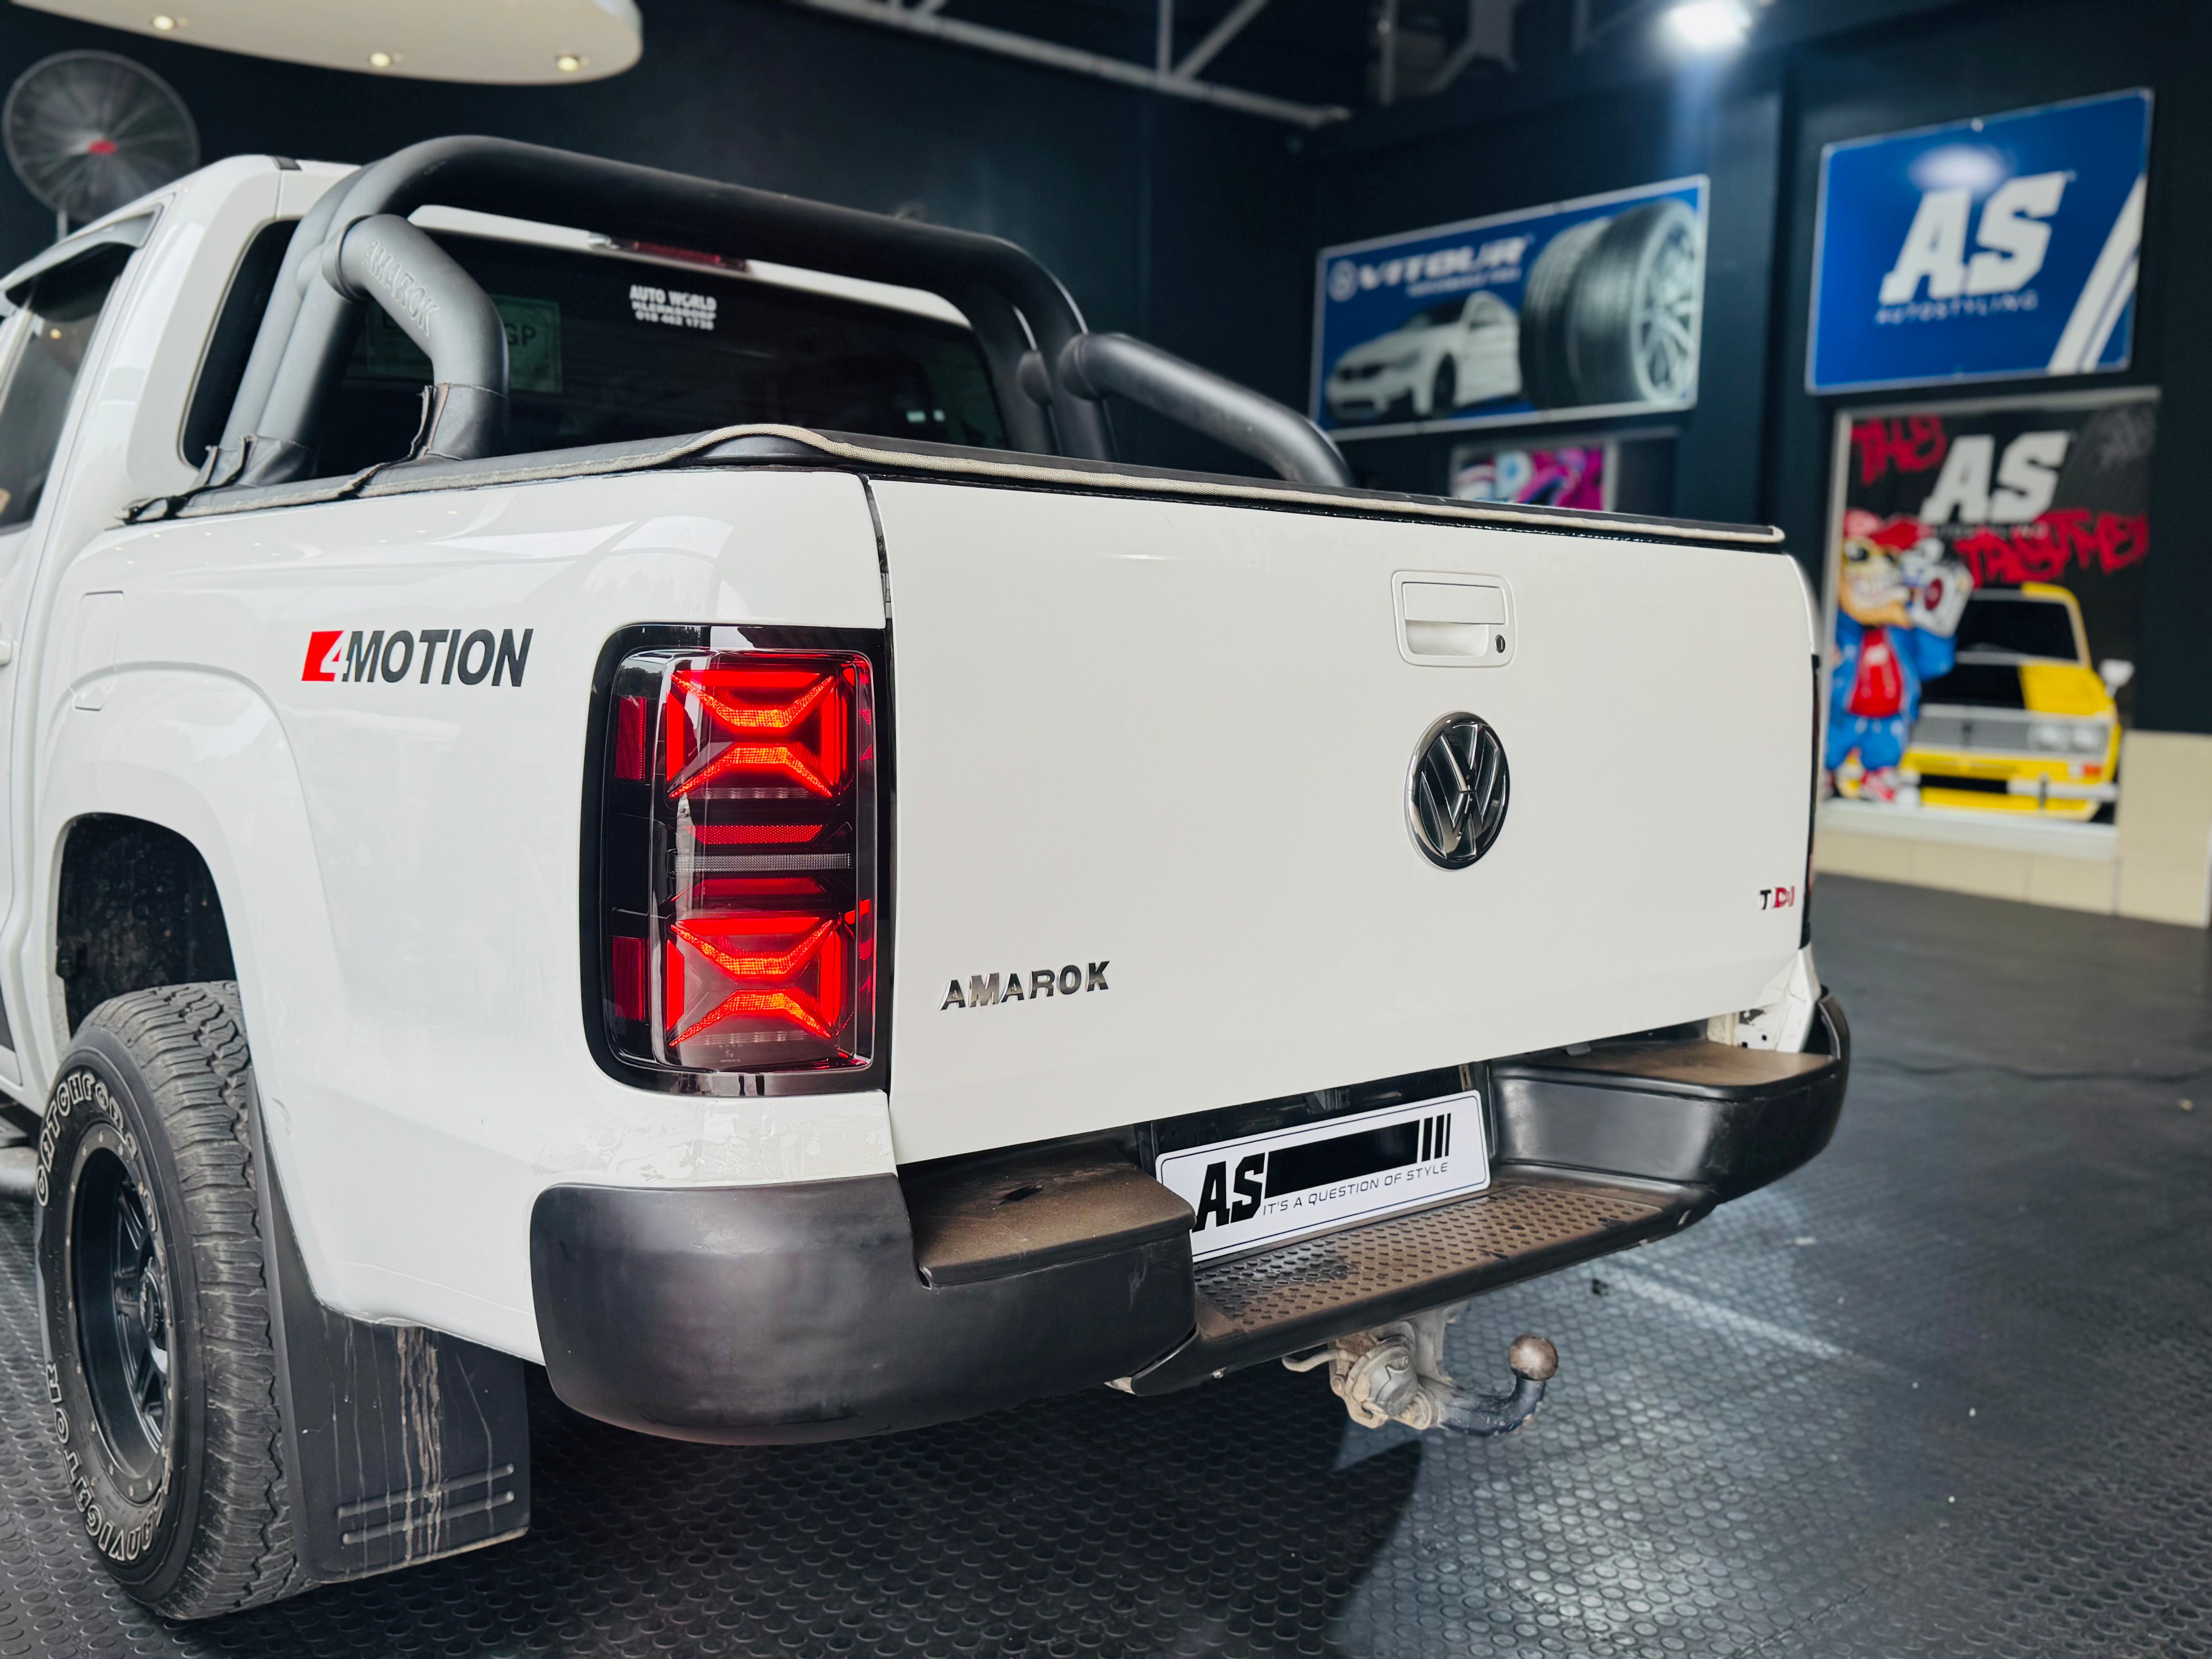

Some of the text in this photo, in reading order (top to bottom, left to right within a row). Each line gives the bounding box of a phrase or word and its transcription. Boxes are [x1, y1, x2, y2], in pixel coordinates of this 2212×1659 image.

[1358, 235, 1528, 290] VITOUR
[1878, 171, 2067, 304] AS
[362, 239, 440, 338] AMAROK
[630, 285, 717, 311] AUTO WORLD
[1919, 431, 2070, 523] AS
[302, 629, 533, 687] 4MOTION
[1760, 886, 1795, 910] TDI
[938, 961, 1110, 1011] AMAROK
[1192, 1152, 1265, 1233] AS
[1263, 1162, 1448, 1216] IT'S A QUESTION OF STYLE
